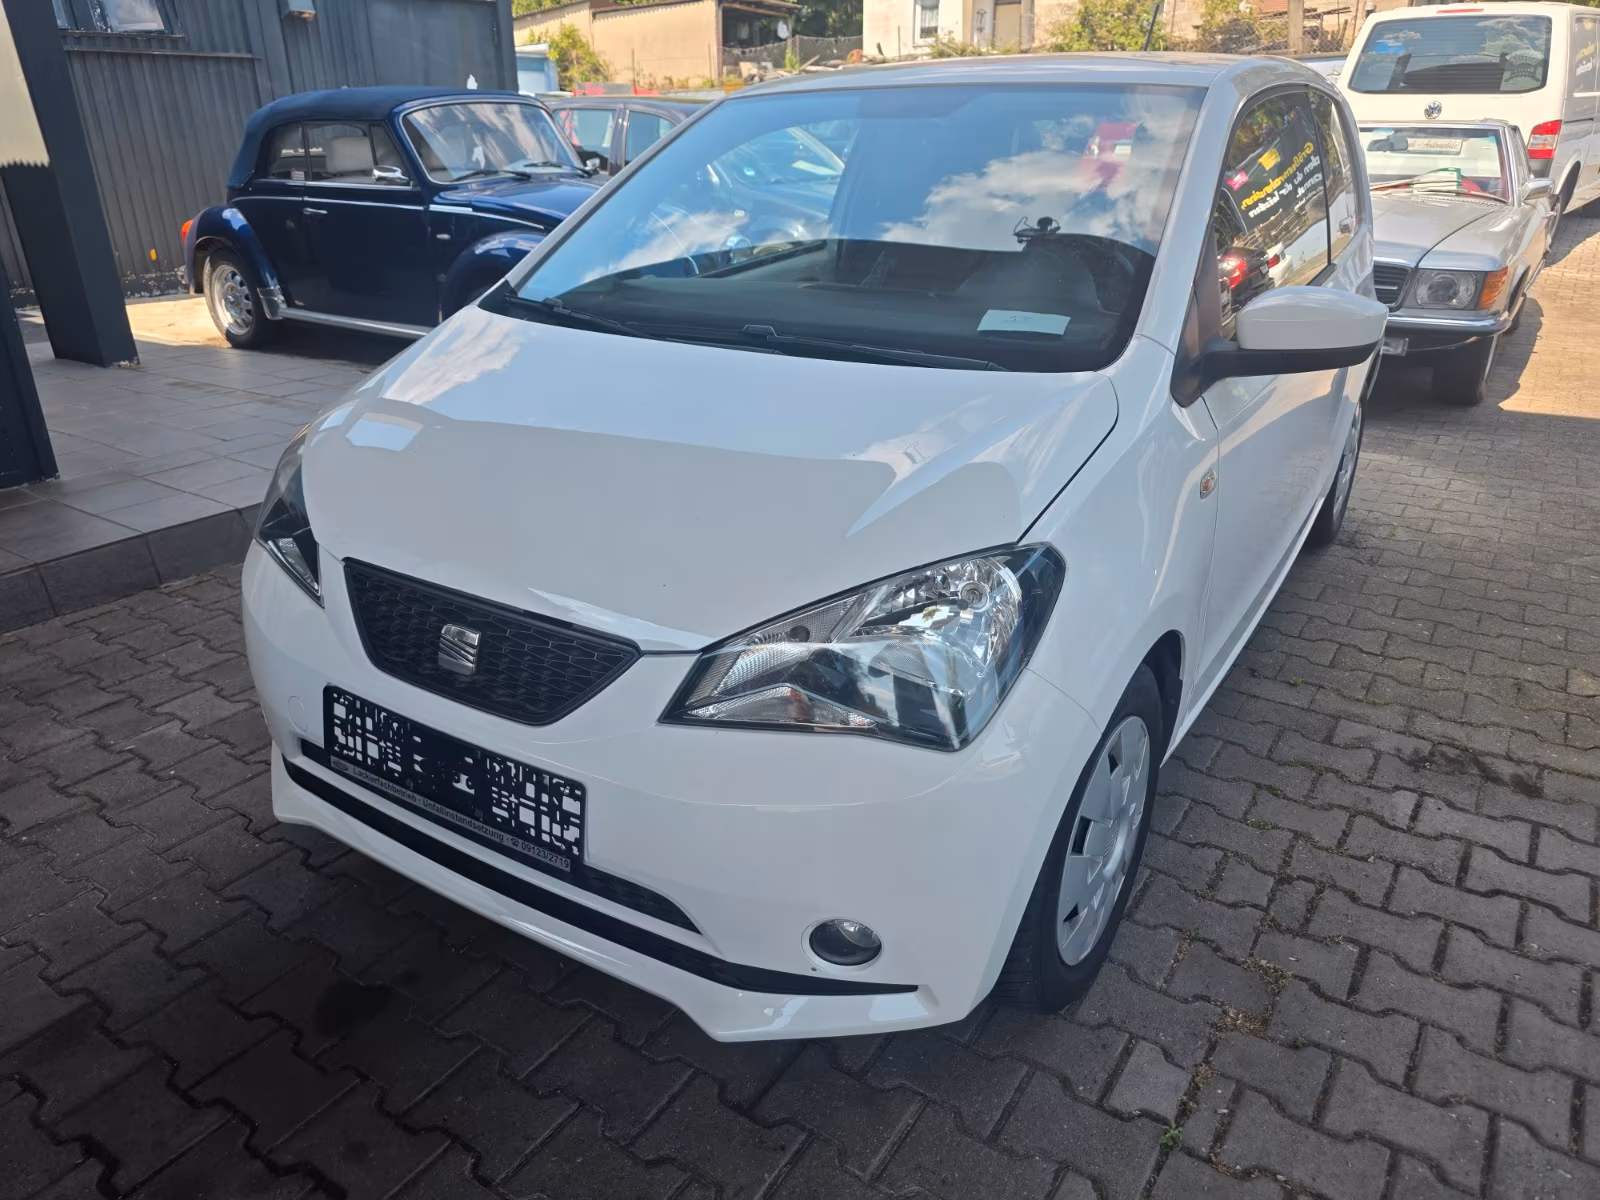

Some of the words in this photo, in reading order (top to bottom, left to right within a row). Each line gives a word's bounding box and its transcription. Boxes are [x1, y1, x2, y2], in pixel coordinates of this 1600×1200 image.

[353, 767, 417, 802] Lackierfachbetrieb
[423, 799, 504, 843] Unfallinstandsetzung
[521, 843, 569, 869] 09123/2719
